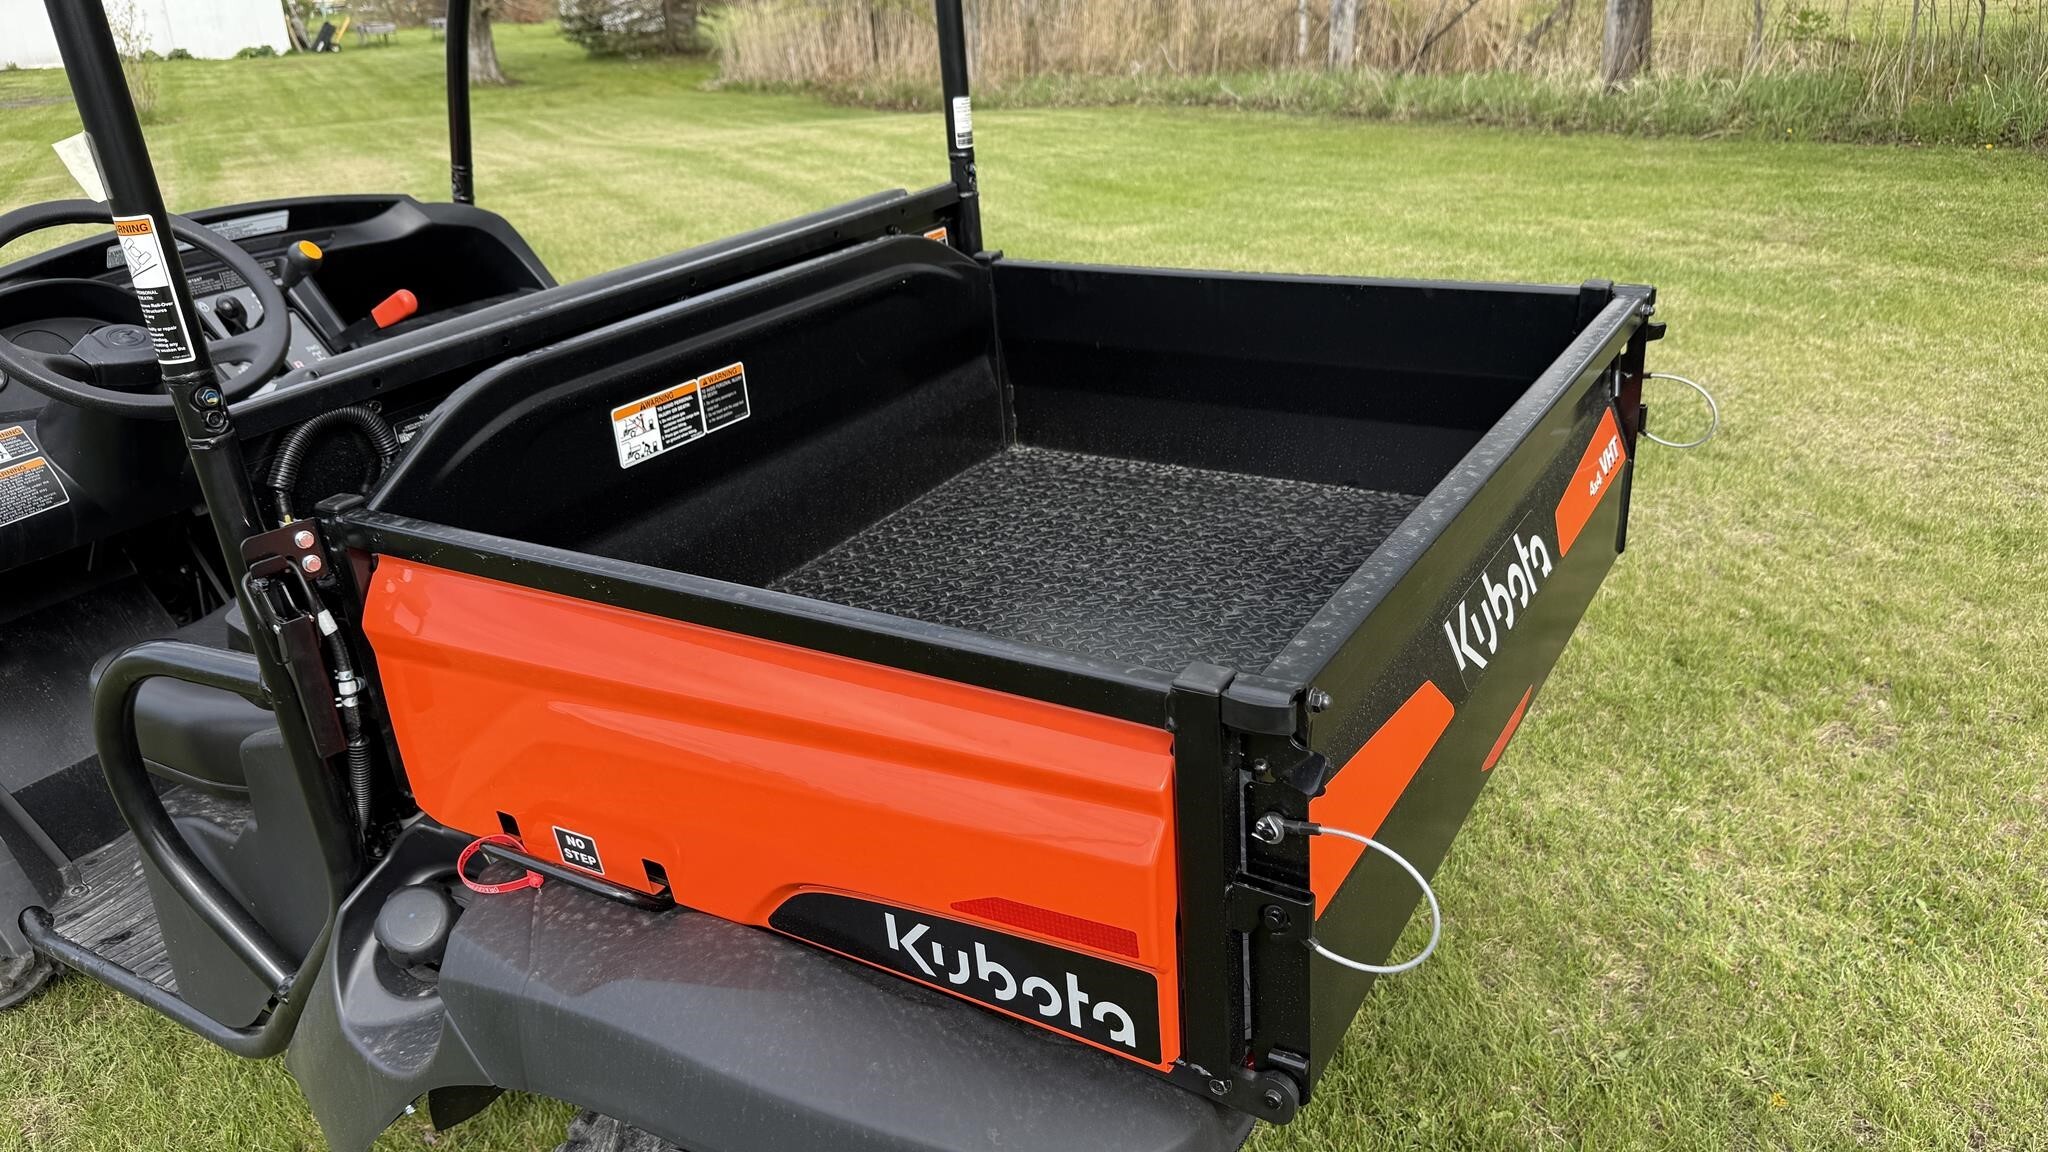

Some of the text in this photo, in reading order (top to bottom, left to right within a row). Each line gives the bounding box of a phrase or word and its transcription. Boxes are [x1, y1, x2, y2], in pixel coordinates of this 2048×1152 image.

[709, 367, 738, 384] WARNING
[645, 391, 674, 408] WARNING
[1590, 434, 1619, 496] 4x4 VHT
[1444, 533, 1552, 671] Kubota
[565, 834, 585, 849] NO
[563, 847, 597, 866] STEP
[884, 912, 1136, 1048] Kubota
